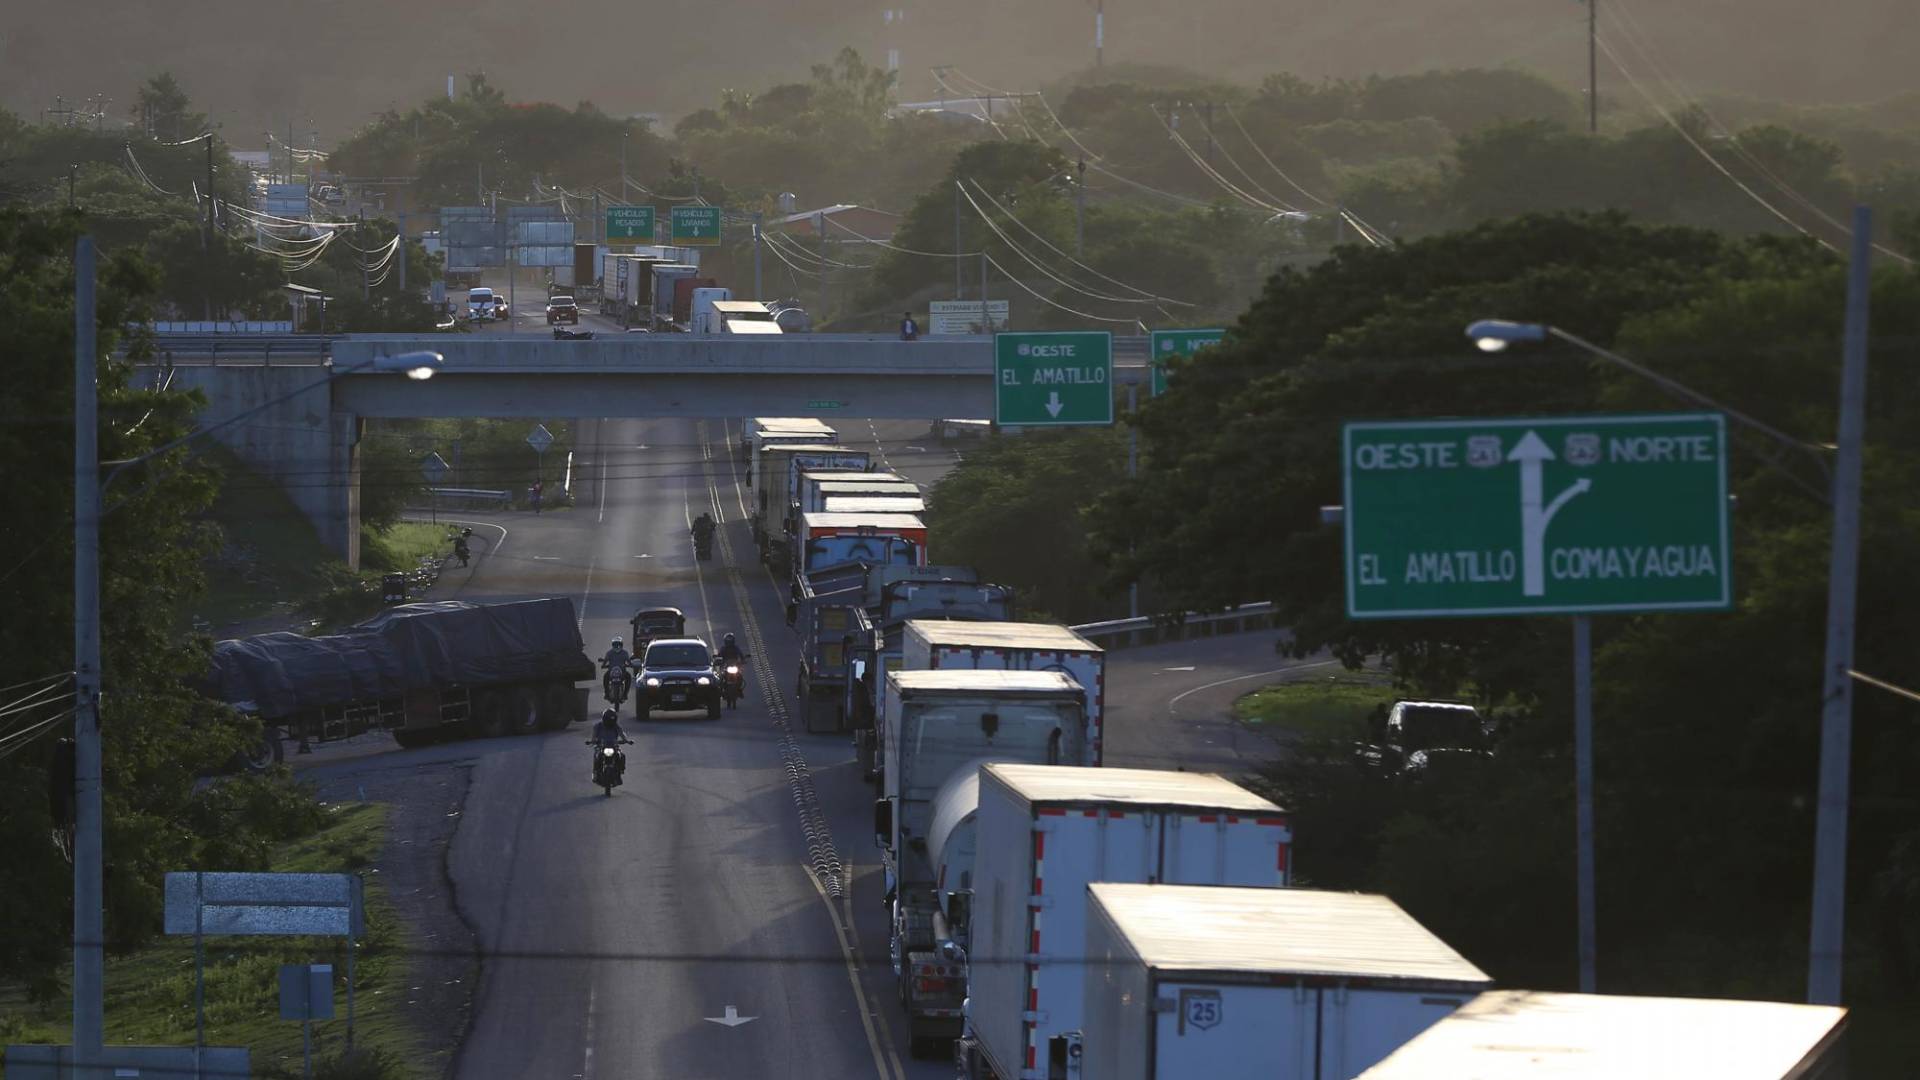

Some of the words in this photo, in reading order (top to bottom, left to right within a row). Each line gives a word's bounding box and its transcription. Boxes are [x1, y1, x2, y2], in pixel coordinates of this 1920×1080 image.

[1032, 345, 1076, 357] OESTE
[1002, 369, 1021, 385] EL
[1032, 367, 1105, 384] AMATILLO
[1355, 442, 1458, 469] OESTE
[1610, 436, 1715, 462] NORTE
[1359, 554, 1387, 585] EL
[1405, 550, 1516, 583] AMATILLO
[1551, 545, 1717, 579] COMAYAGUA
[1193, 1003, 1215, 1021] 25
